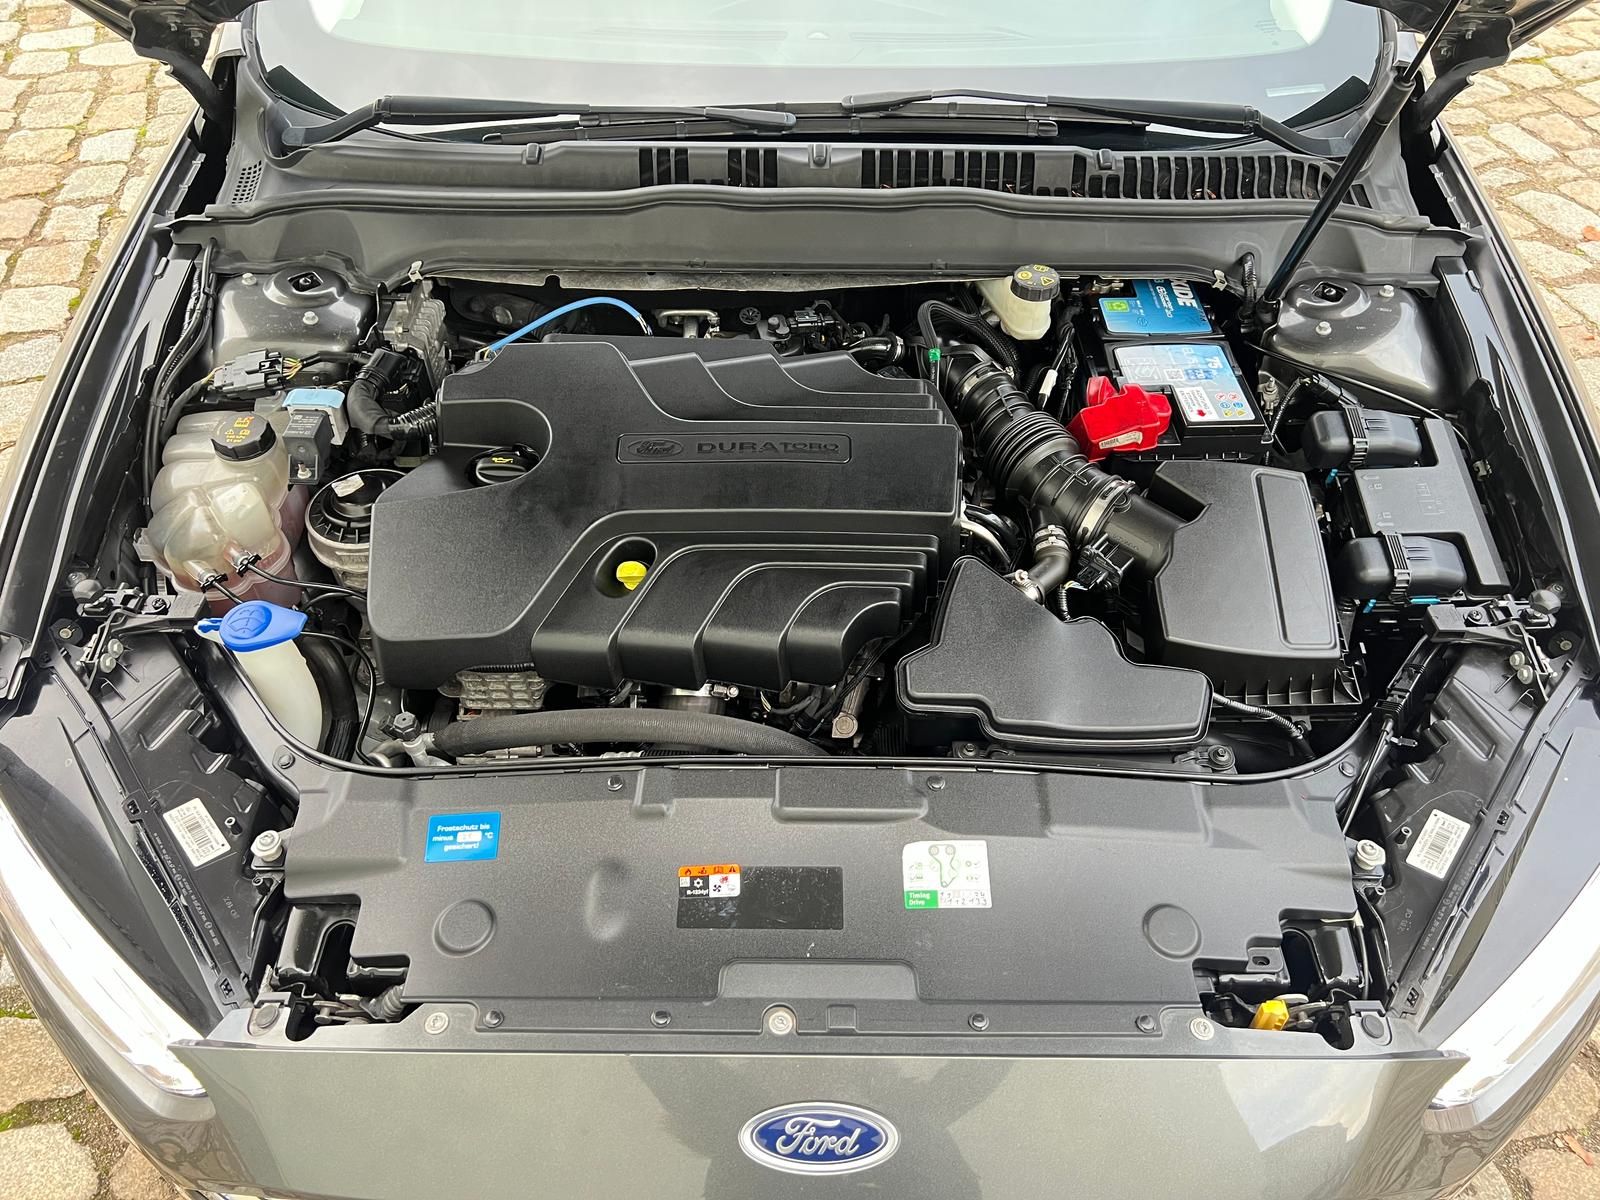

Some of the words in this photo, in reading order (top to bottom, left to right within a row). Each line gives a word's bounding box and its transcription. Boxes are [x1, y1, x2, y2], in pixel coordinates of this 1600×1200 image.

[1169, 279, 1199, 309] XIDE
[1205, 356, 1224, 369] 75
[635, 440, 676, 456] Ford
[697, 441, 839, 455] DURATORQ
[437, 824, 479, 832] Frostschutz
[432, 834, 454, 842] minus
[908, 892, 931, 900] Timing
[775, 1116, 862, 1156] Ford
